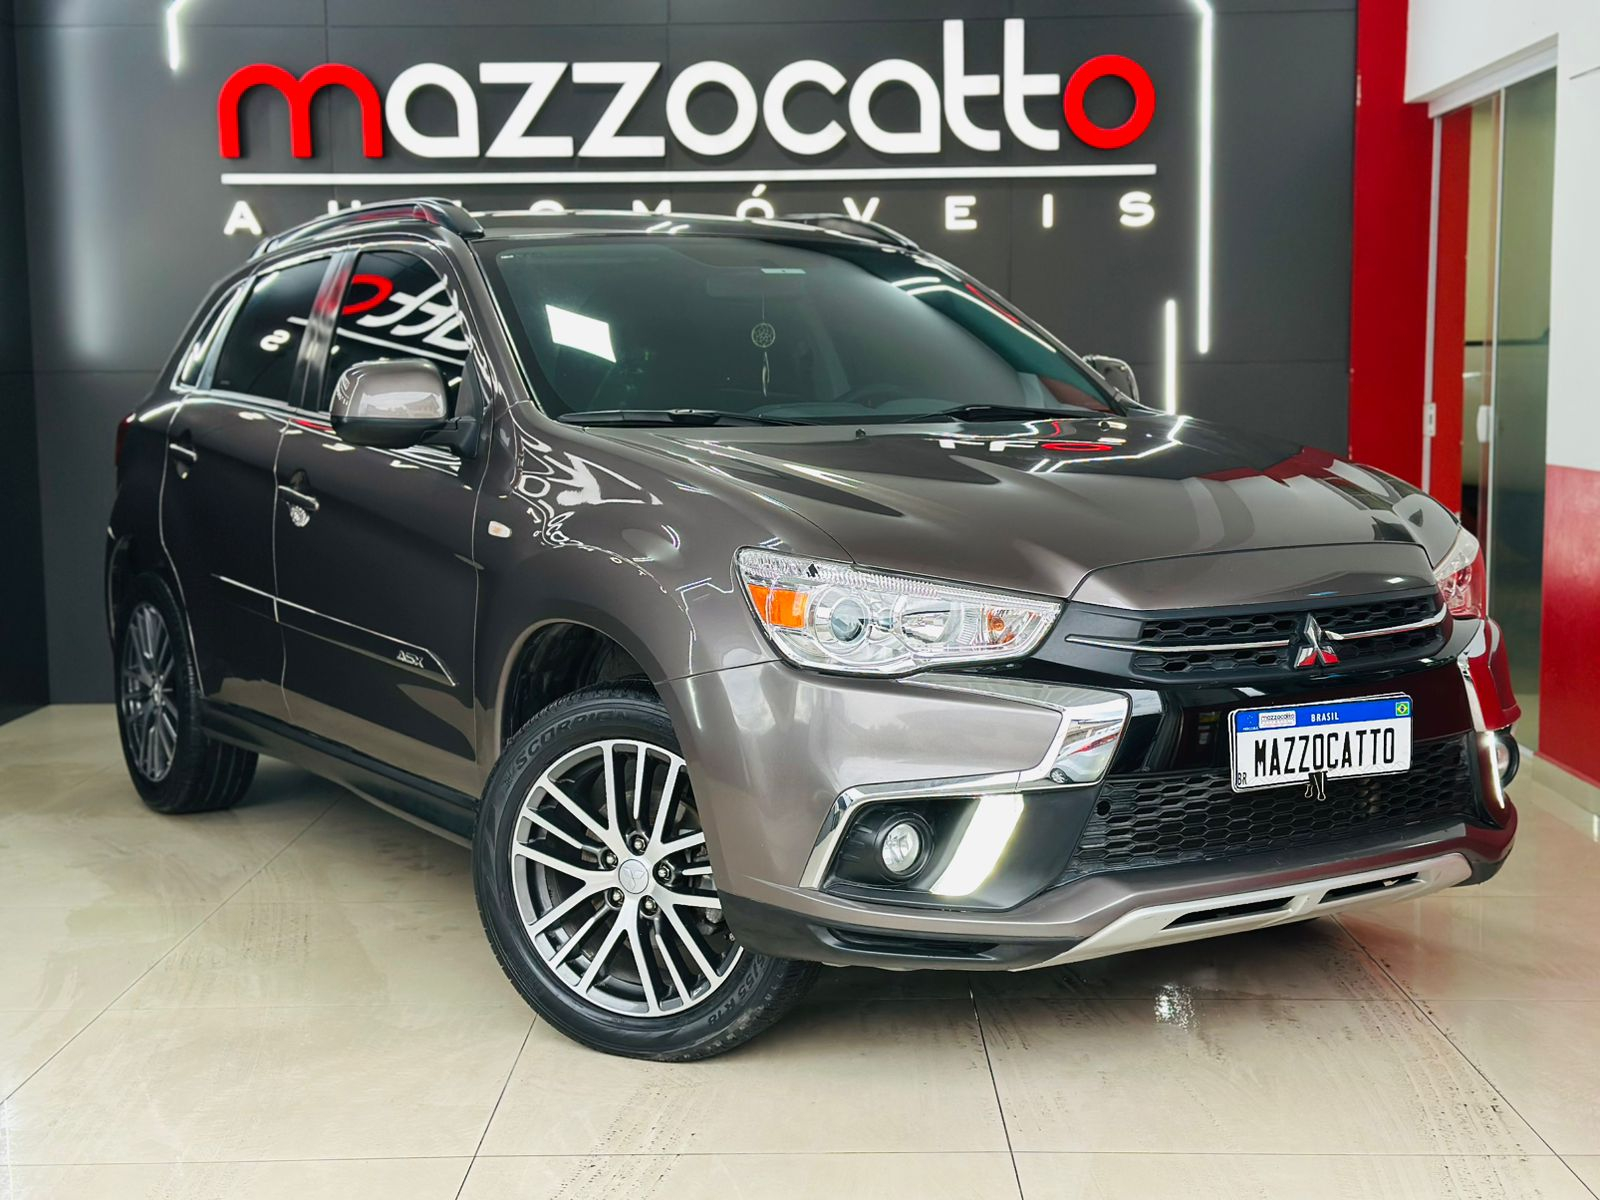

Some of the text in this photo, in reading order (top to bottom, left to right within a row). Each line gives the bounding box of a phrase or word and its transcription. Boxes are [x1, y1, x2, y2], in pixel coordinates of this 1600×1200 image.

[217, 18, 1156, 160] mazzocatto
[1310, 711, 1339, 723] BRASIL
[1254, 727, 1395, 778] MAZZOCATTO
[1236, 771, 1248, 786] BR
